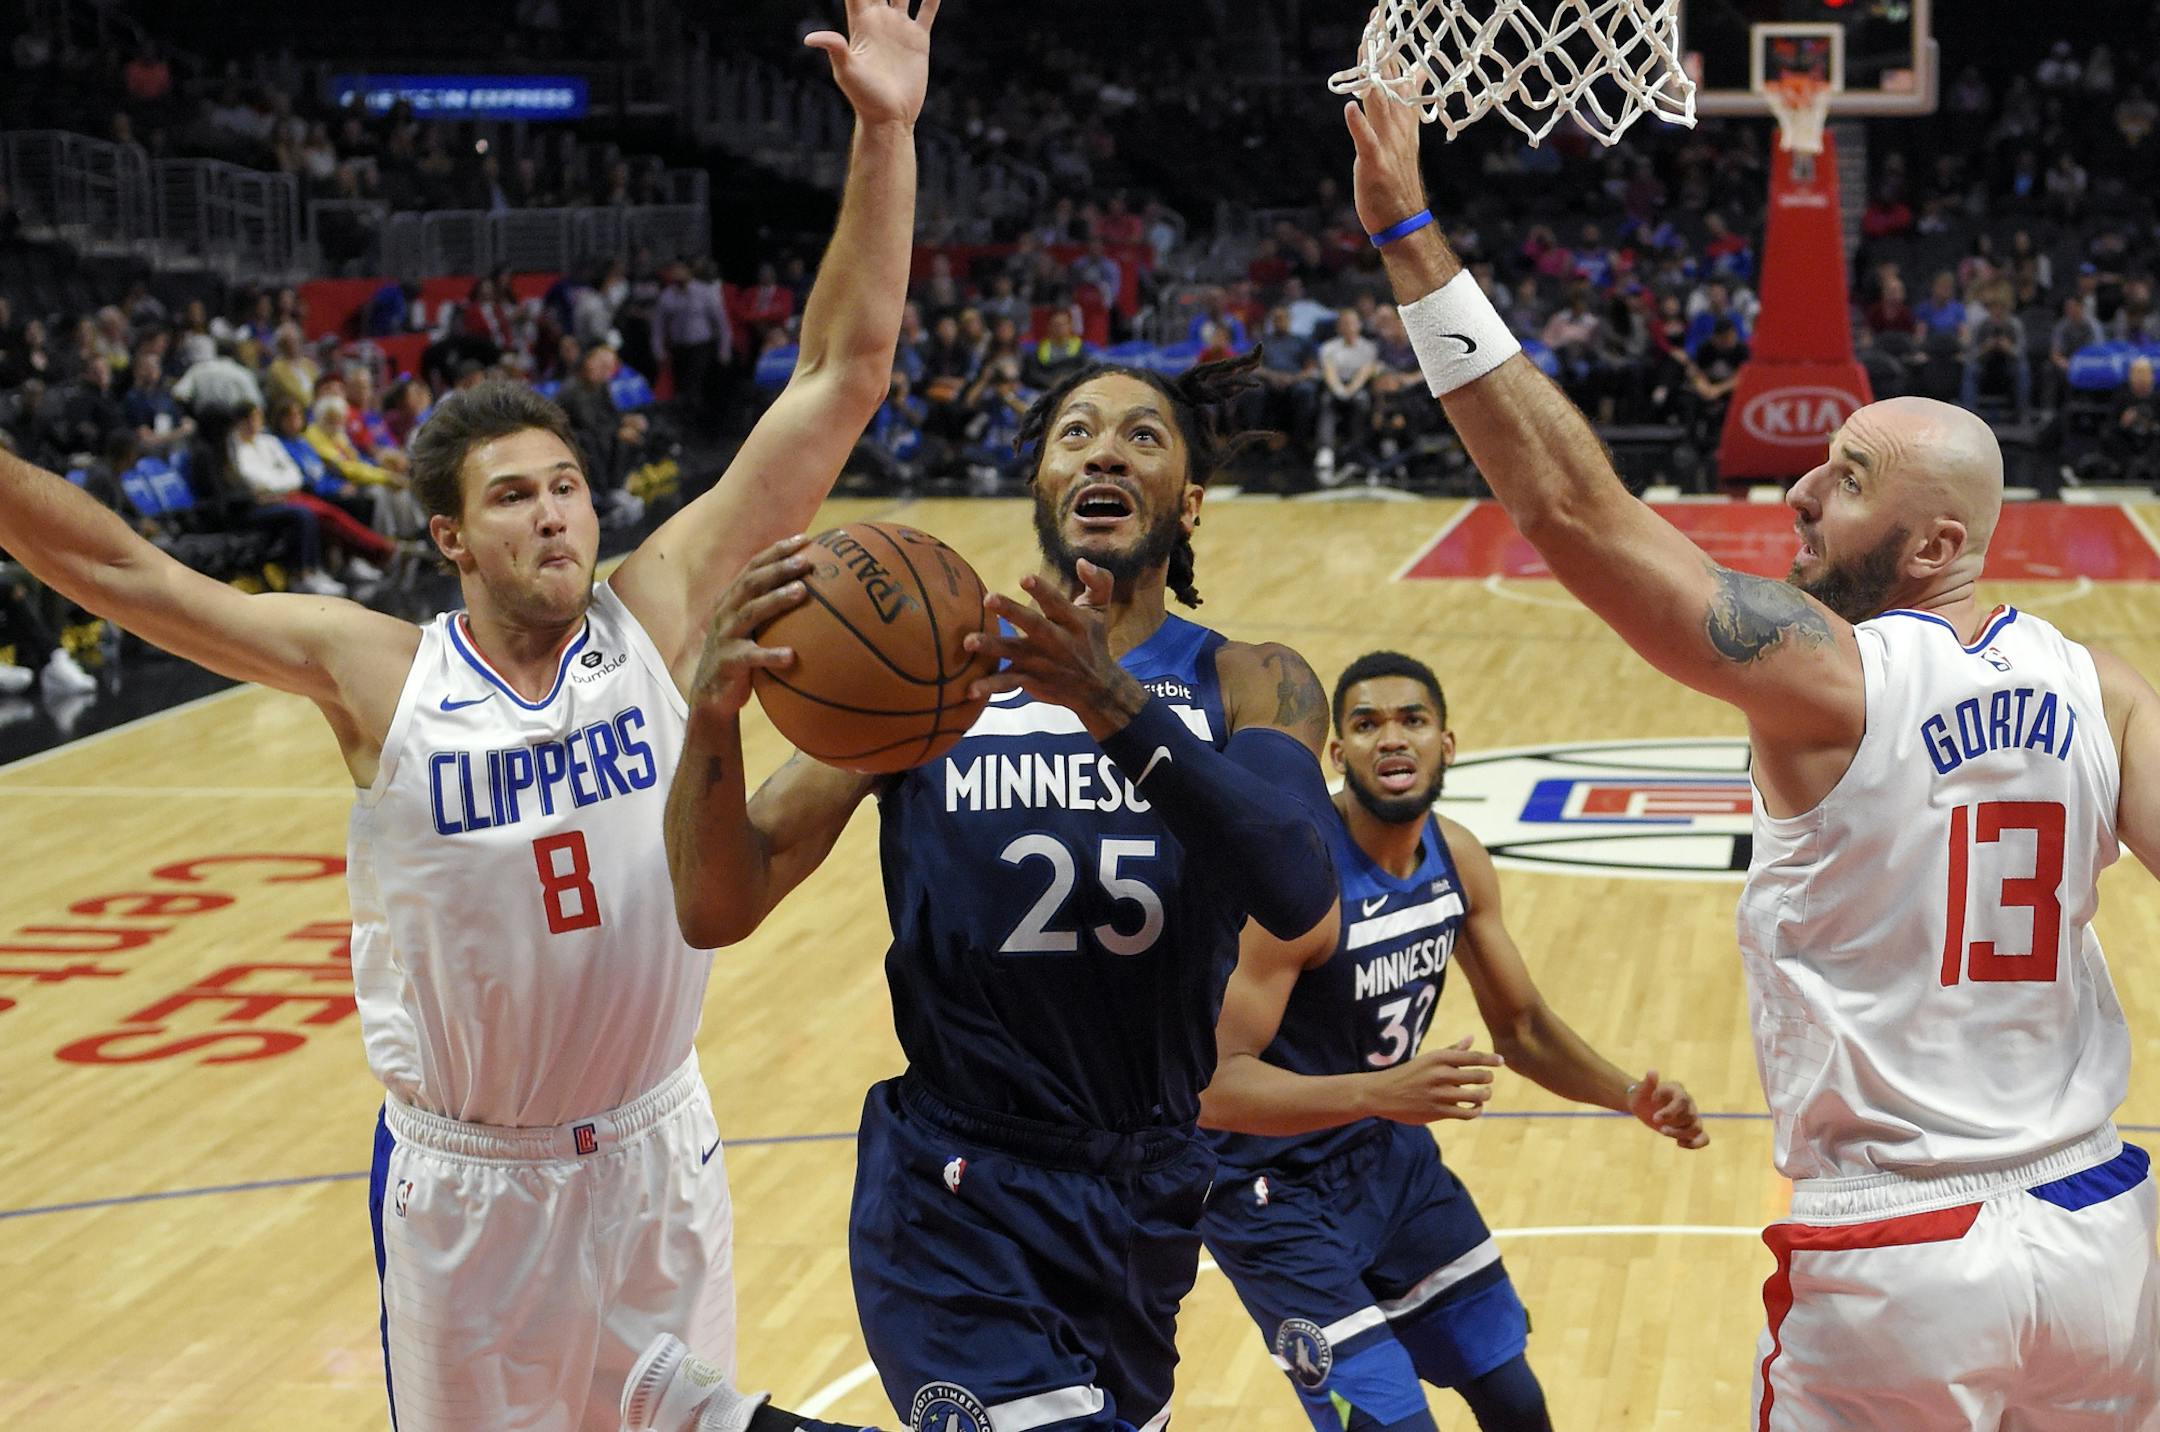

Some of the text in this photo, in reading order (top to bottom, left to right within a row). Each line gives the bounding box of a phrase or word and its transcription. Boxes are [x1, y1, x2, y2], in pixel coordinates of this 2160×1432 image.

[1763, 401, 1842, 432] KIA
[571, 653, 627, 683] bumble
[429, 706, 657, 836] CLIPPERS
[1921, 688, 2077, 775] GORTAT
[532, 830, 601, 935] 8
[999, 834, 1165, 956] 25
[1940, 801, 2066, 987] 13
[1367, 984, 1436, 1067] 32
[937, 1387, 991, 1432] TIMBERWO
